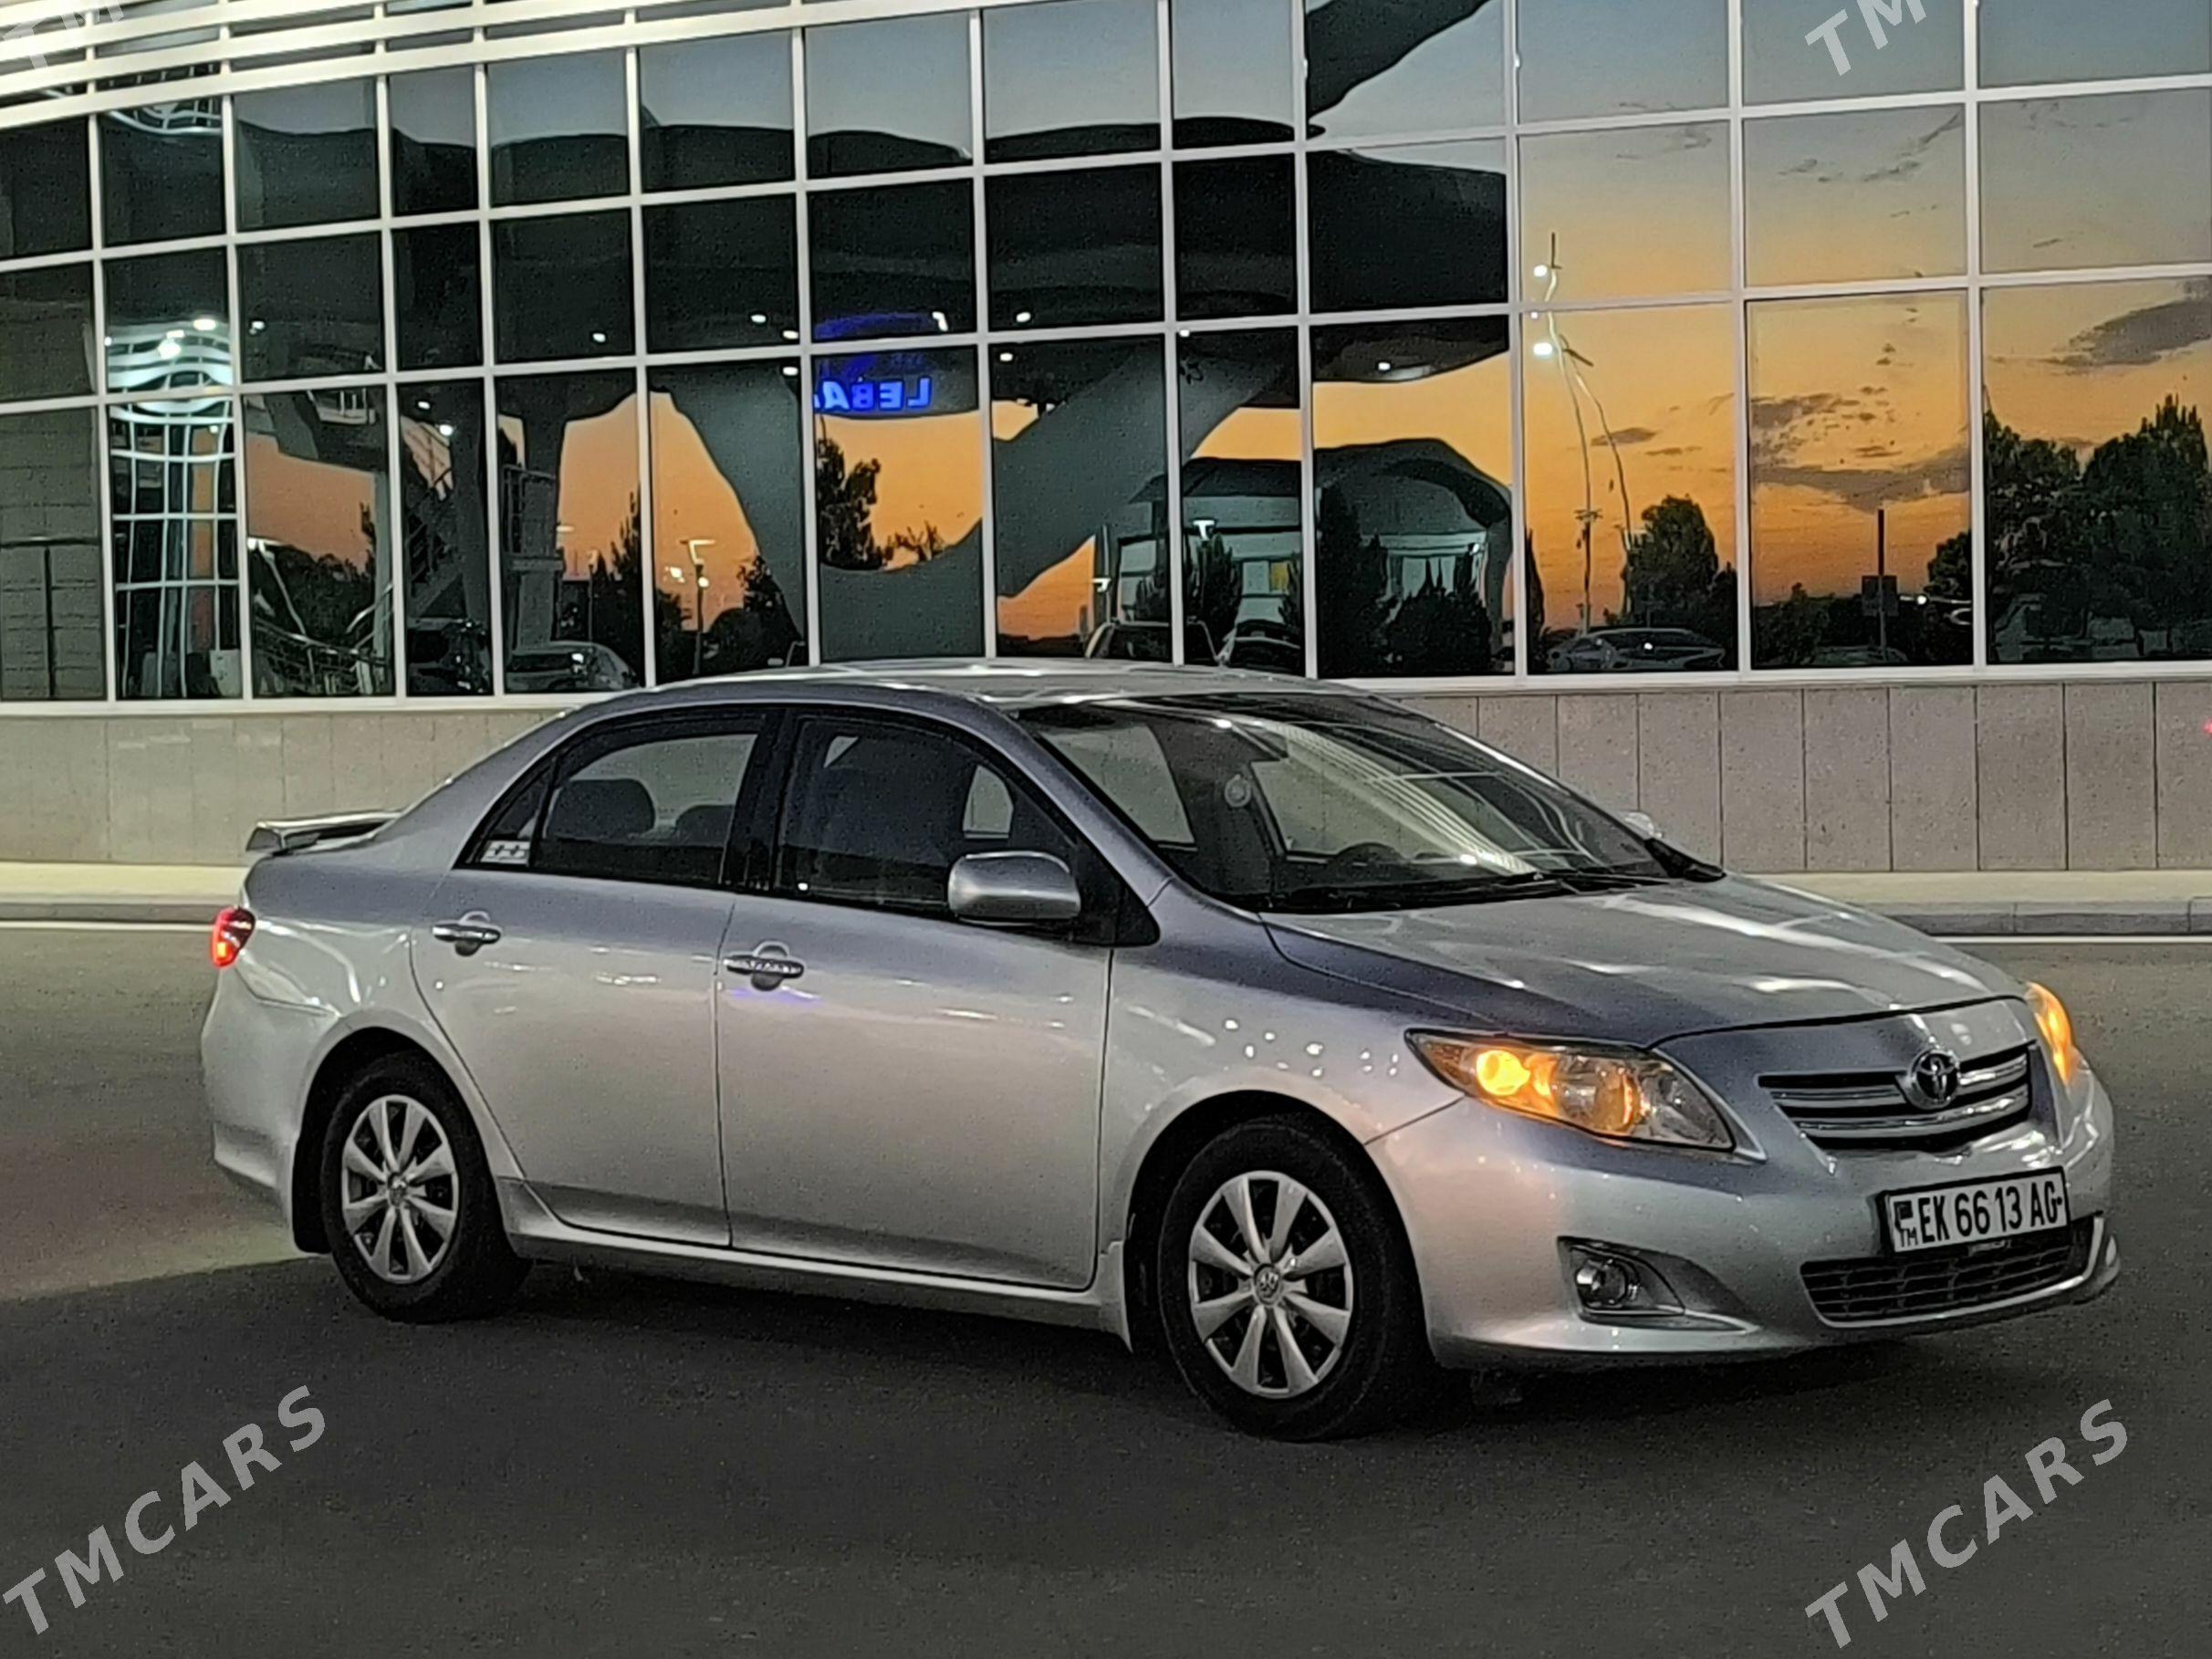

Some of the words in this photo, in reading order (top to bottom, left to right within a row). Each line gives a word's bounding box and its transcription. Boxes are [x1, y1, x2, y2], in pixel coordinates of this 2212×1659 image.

[1918, 1195, 1950, 1244] EK
[1955, 1186, 2023, 1237] 6613
[2030, 1181, 2059, 1228] AG
